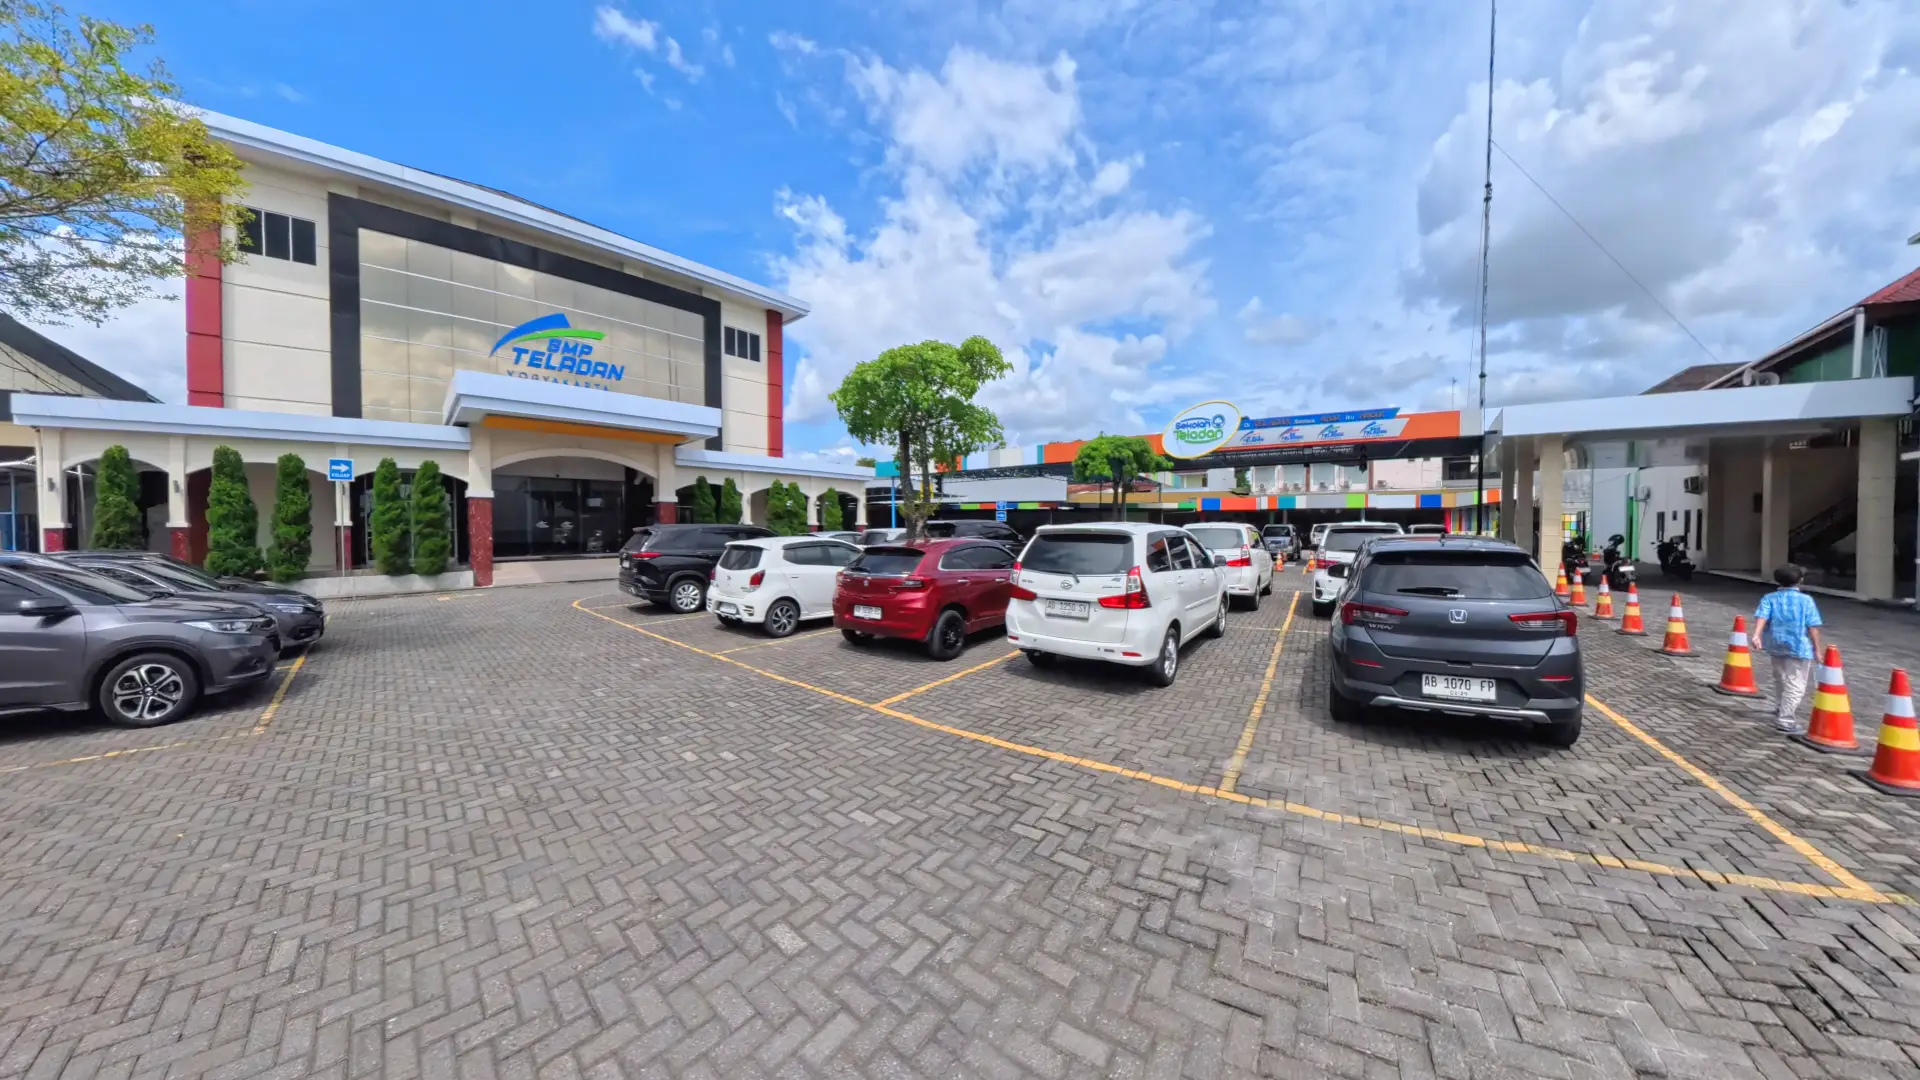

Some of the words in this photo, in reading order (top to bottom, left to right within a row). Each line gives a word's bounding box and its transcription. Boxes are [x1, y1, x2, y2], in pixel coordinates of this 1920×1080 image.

[547, 338, 593, 357] SMP
[512, 346, 625, 381] TELADAN
[1173, 428, 1223, 441] Teladan
[1060, 602, 1076, 611] 1250
[1424, 676, 1437, 687] AB
[1444, 678, 1471, 690] 1070
[1480, 681, 1494, 692] FP
